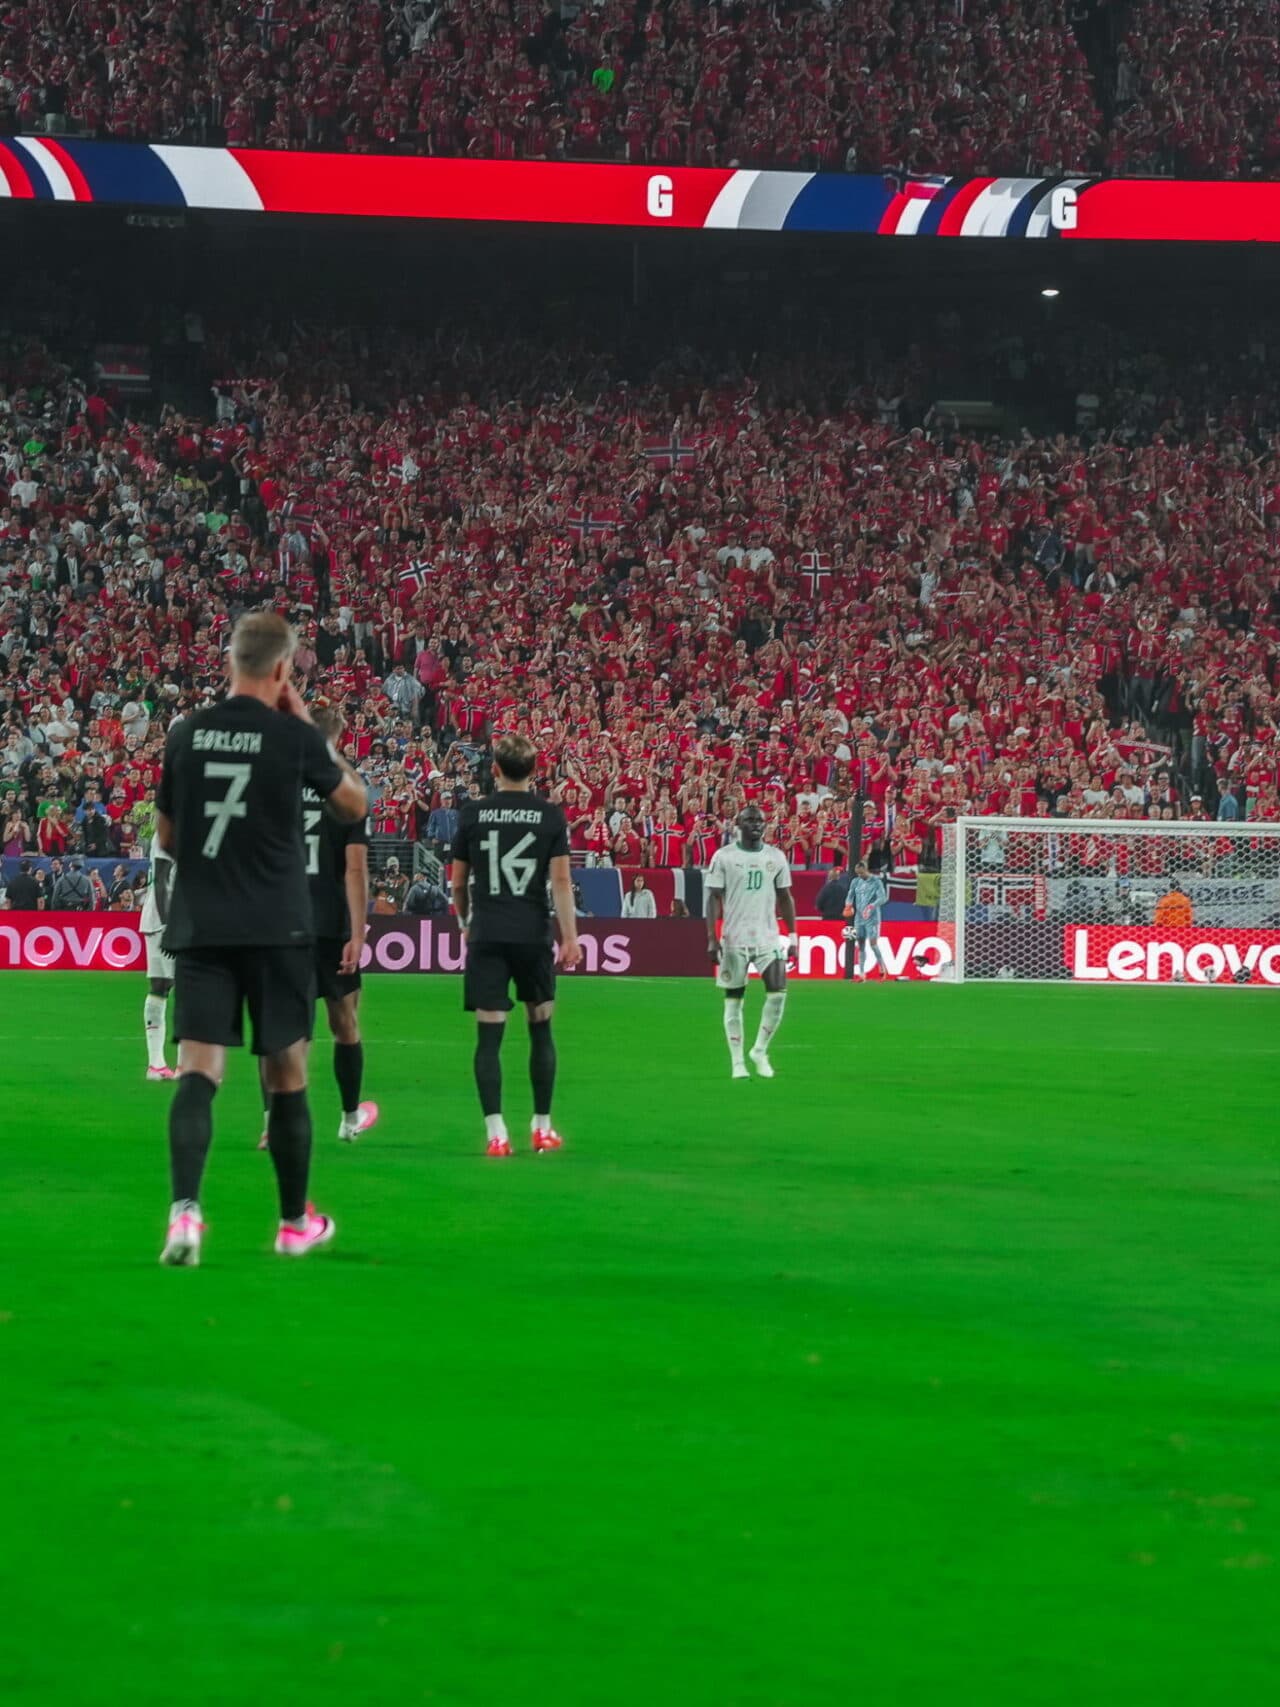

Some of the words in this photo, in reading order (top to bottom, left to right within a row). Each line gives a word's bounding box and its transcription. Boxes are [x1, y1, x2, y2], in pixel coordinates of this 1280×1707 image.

[648, 174, 674, 218] G
[1051, 187, 1078, 230] G
[202, 761, 252, 859] 7
[478, 808, 543, 824] HOLMGREN
[479, 830, 537, 896] 16
[746, 870, 763, 891] 10
